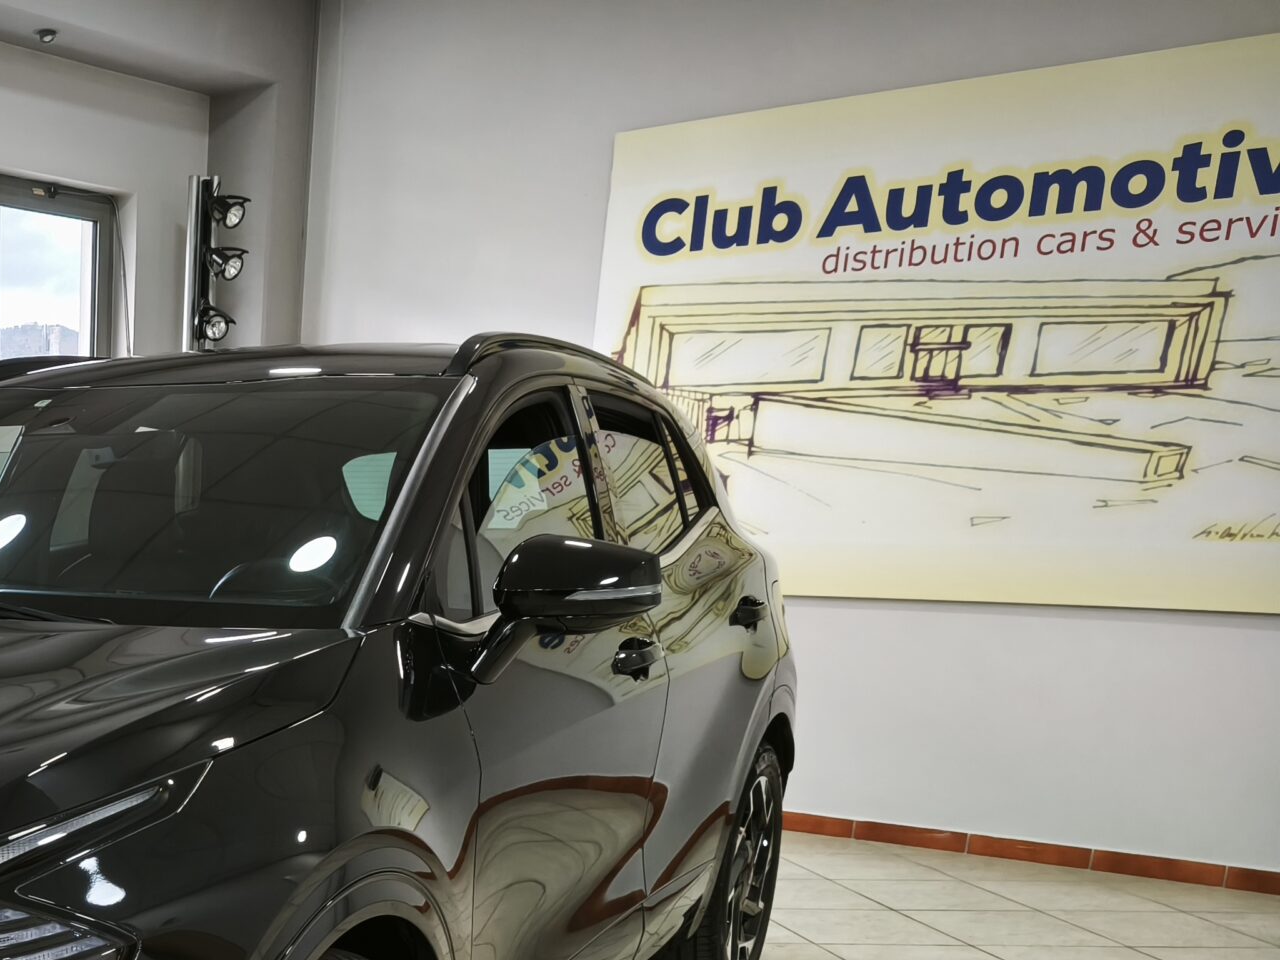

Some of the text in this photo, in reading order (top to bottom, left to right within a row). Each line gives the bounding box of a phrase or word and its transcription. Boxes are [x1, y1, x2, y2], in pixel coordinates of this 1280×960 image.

[641, 186, 803, 256] Club
[820, 233, 1020, 275] distribution
[1035, 228, 1116, 256] cars
[1131, 218, 1160, 248] &
